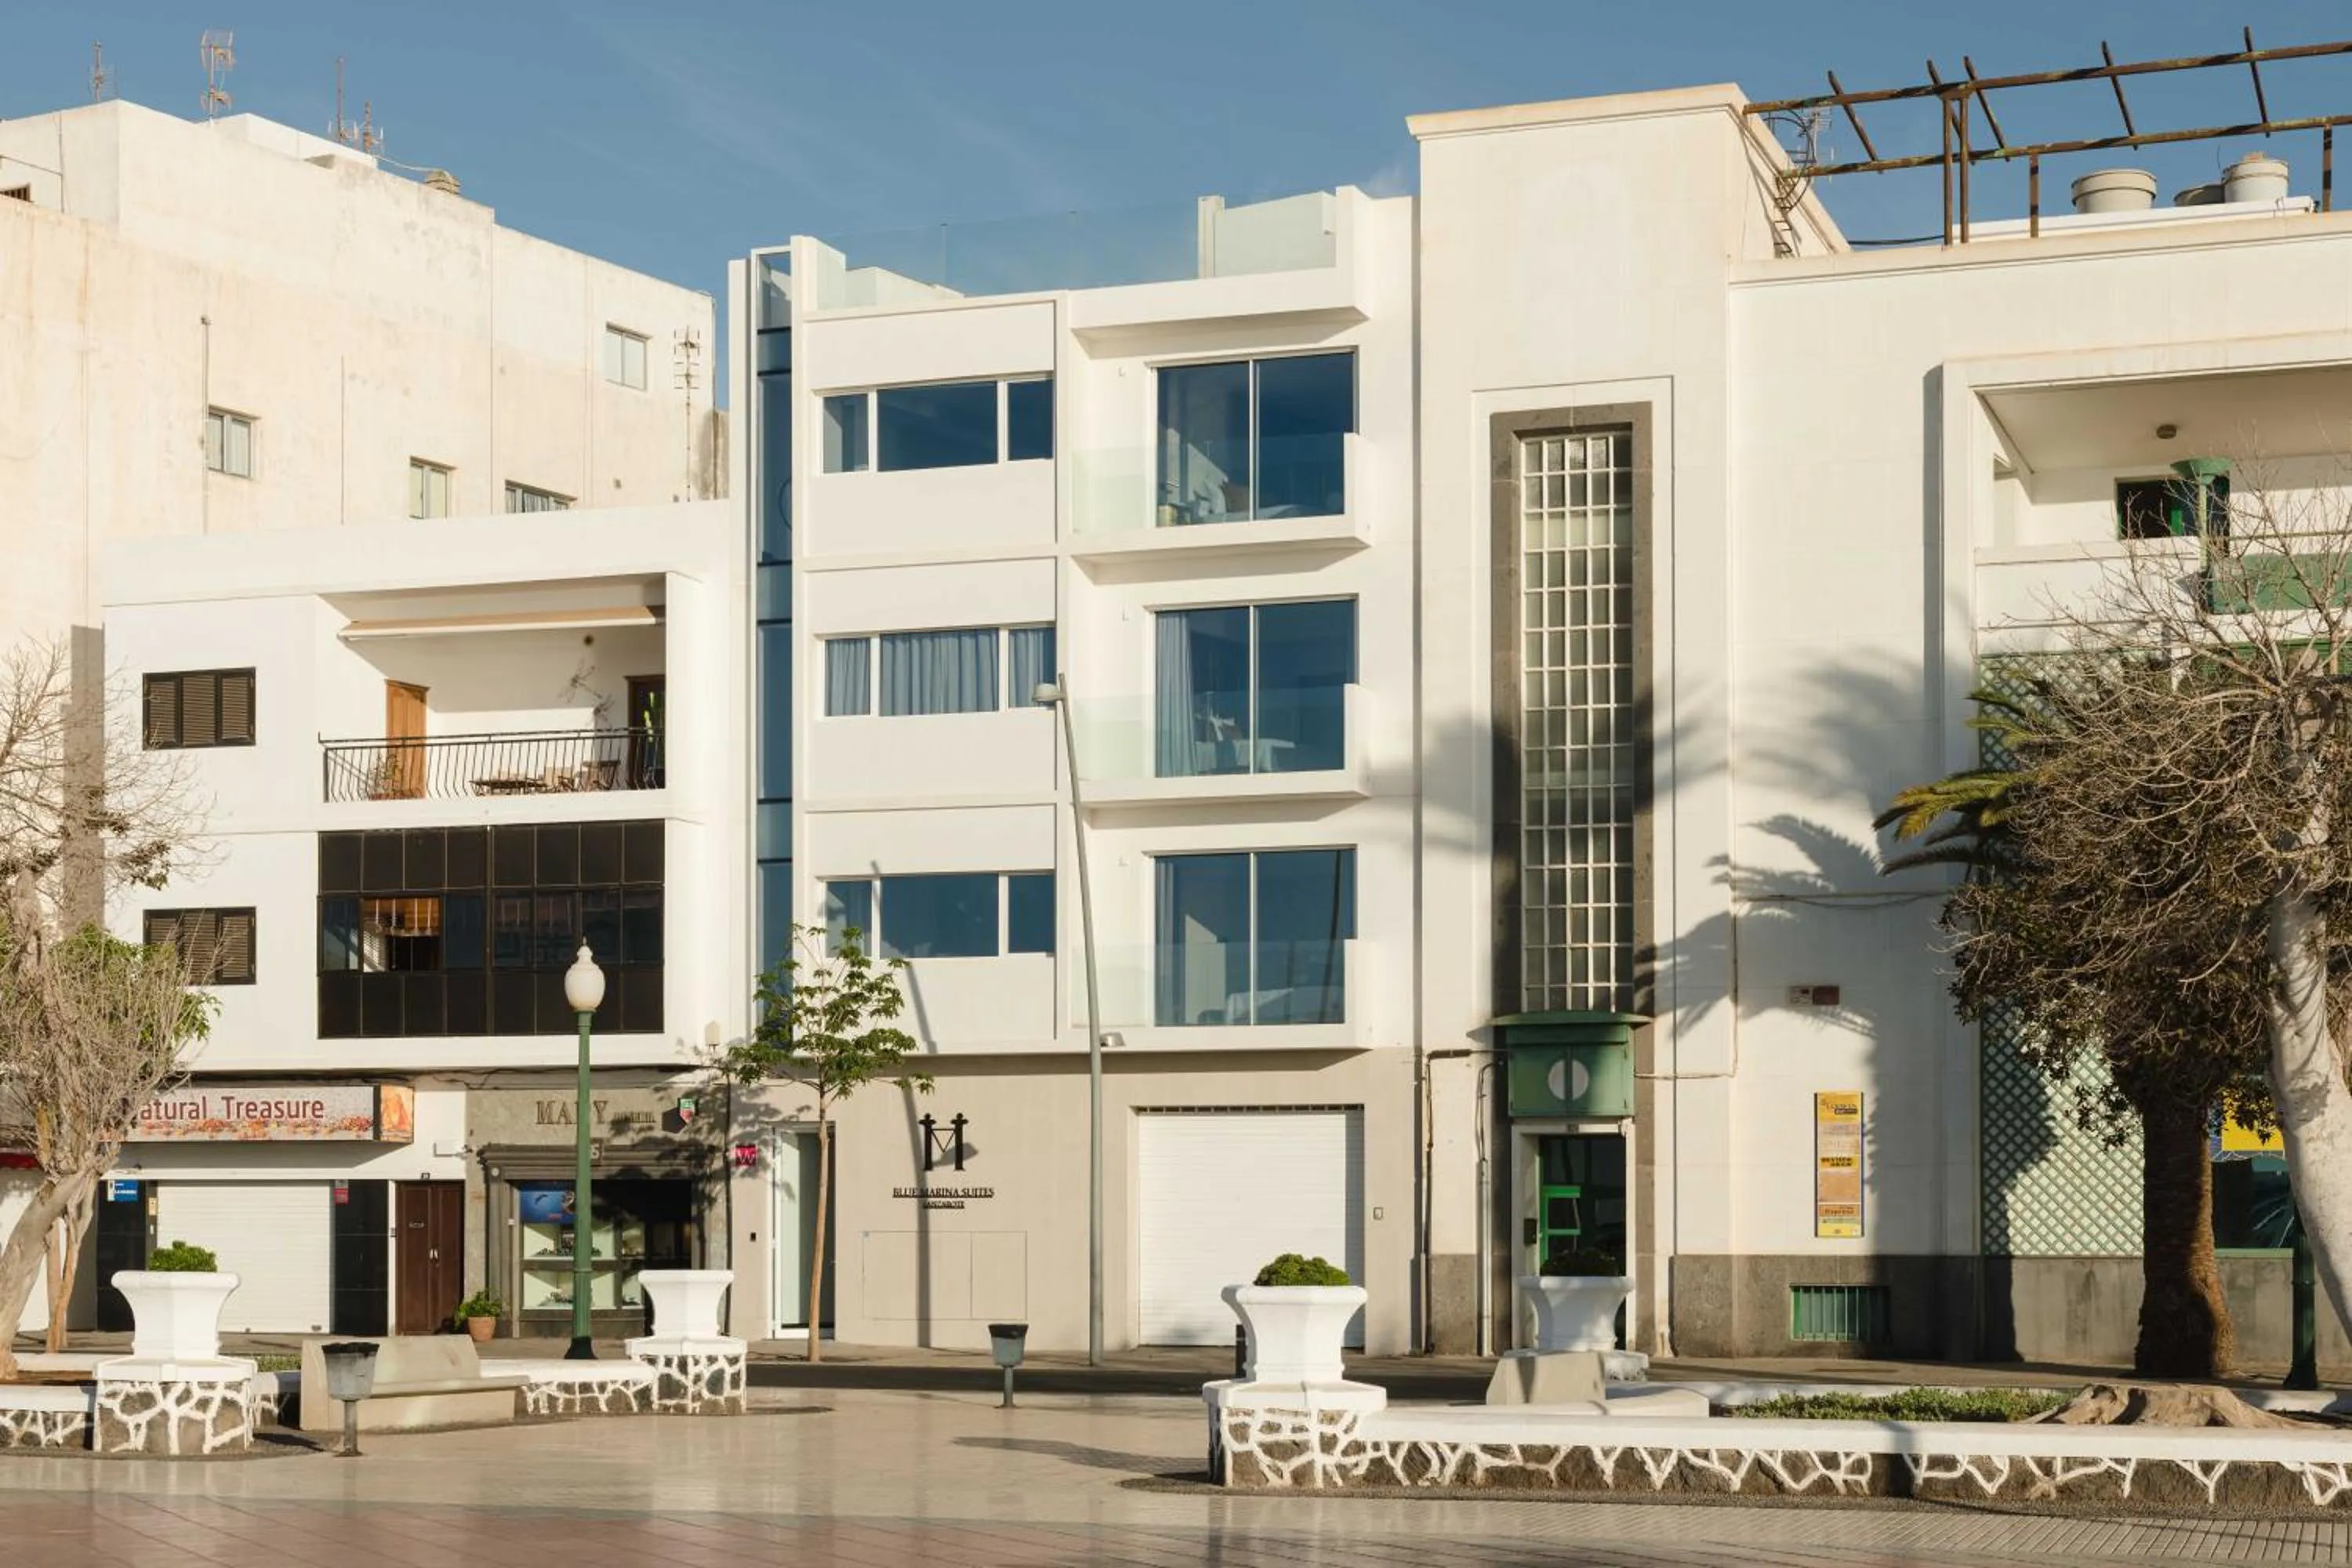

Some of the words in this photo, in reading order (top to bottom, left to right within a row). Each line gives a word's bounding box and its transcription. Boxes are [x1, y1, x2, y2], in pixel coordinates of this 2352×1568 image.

[121, 1095, 208, 1120] atural
[221, 1095, 325, 1120] Treasure
[536, 1100, 608, 1125] MAY
[892, 1187, 917, 1198] BLUE
[919, 1187, 960, 1198] MARINA
[961, 1187, 995, 1198] SUITES
